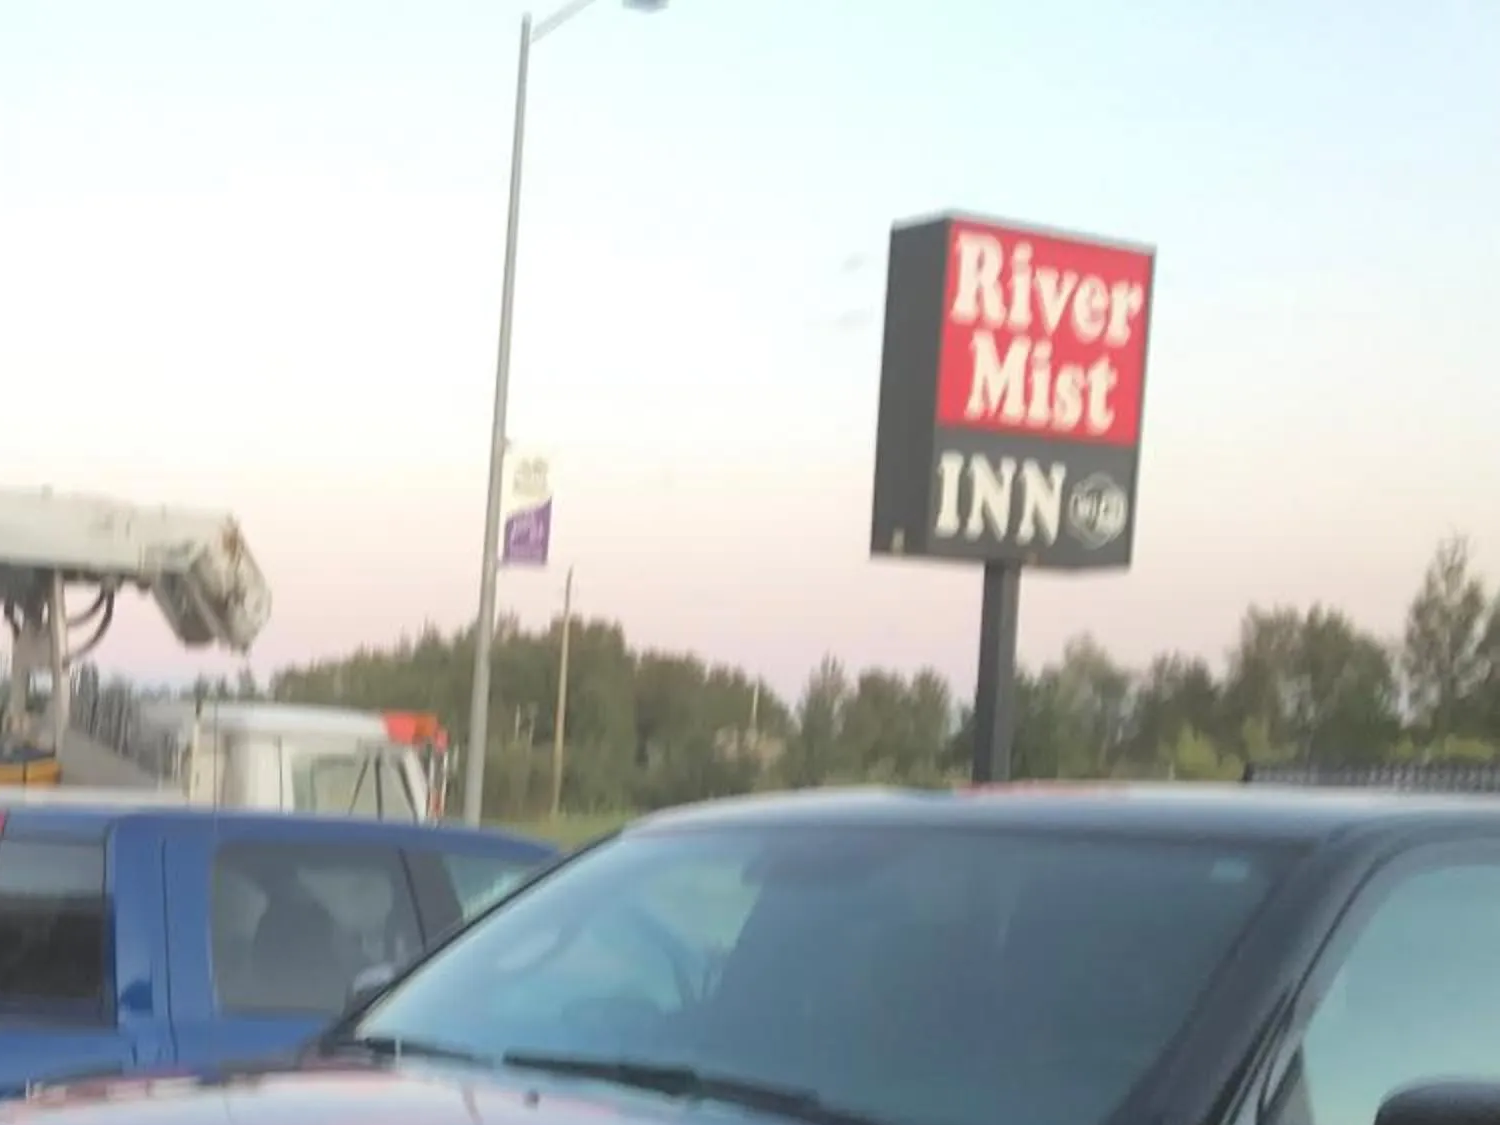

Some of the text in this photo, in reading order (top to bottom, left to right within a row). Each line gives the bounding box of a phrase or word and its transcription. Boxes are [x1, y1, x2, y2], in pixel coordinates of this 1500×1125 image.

[951, 232, 1143, 347] River
[964, 328, 1118, 435] Mist
[935, 450, 1067, 546] INN
